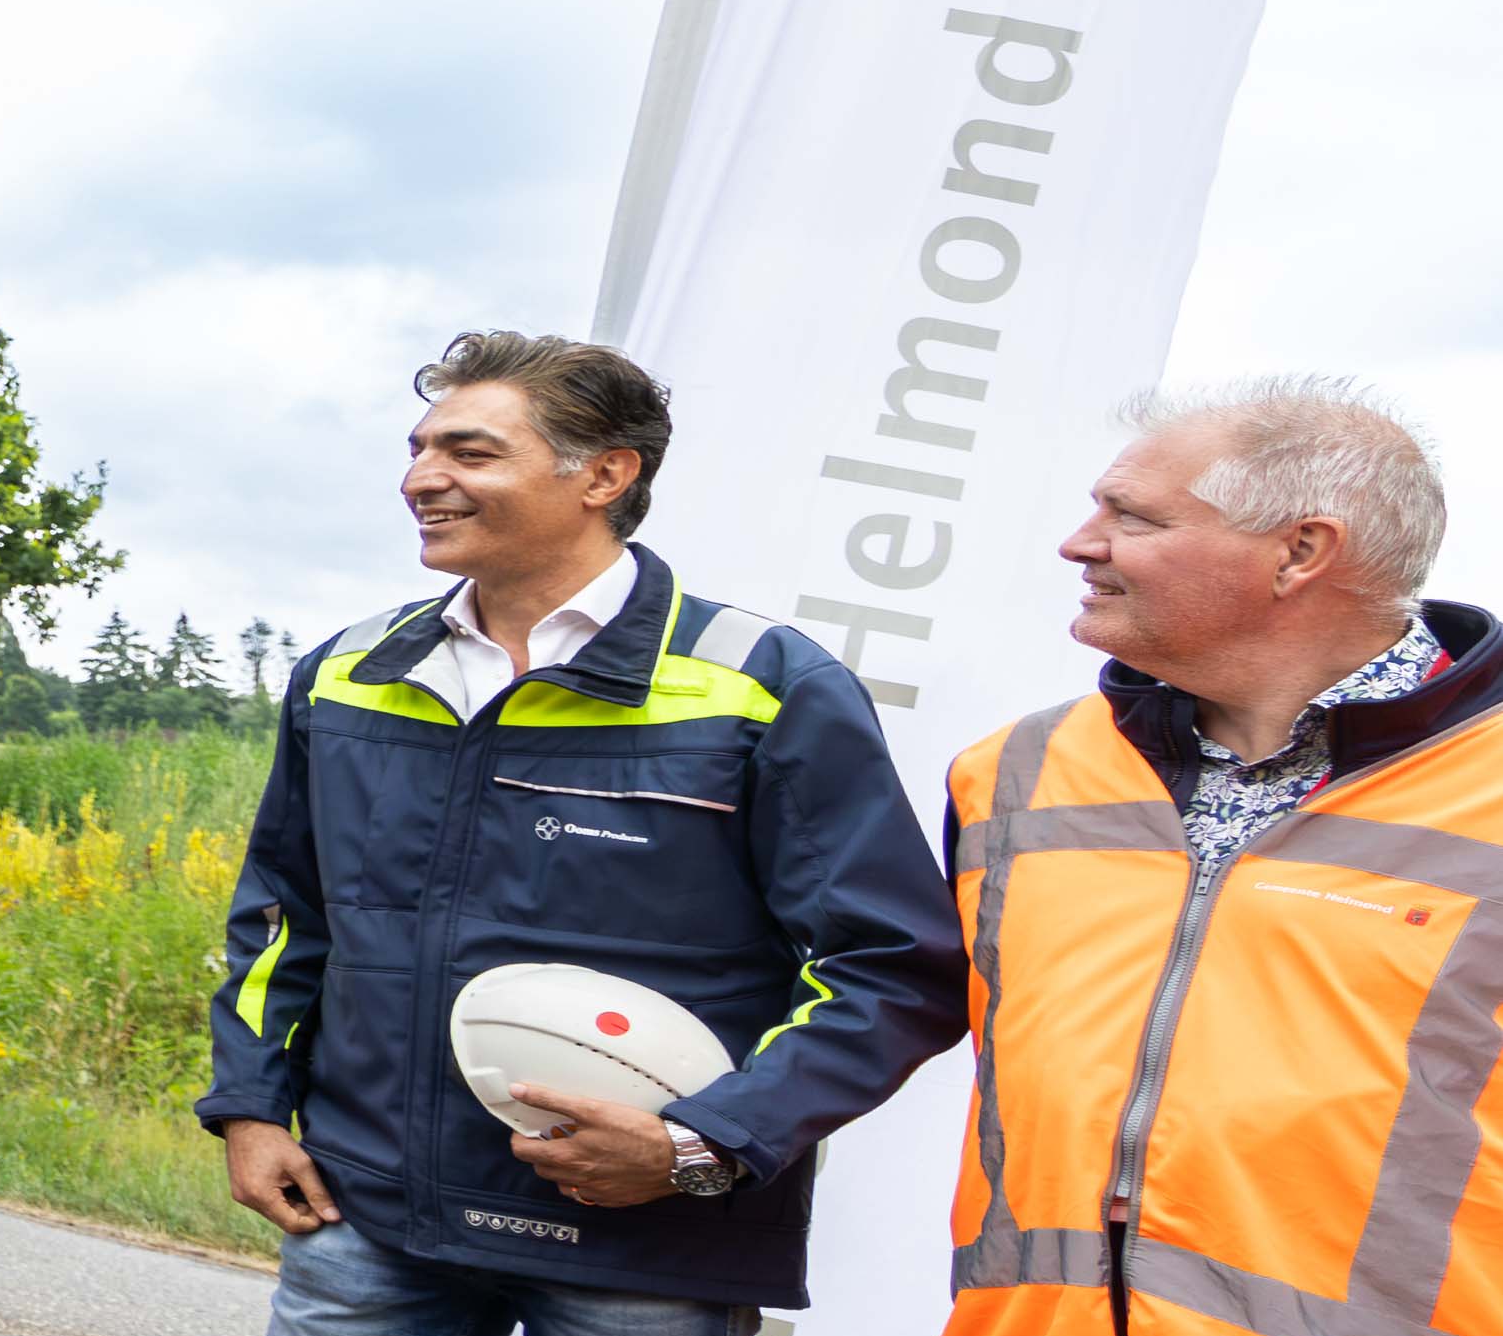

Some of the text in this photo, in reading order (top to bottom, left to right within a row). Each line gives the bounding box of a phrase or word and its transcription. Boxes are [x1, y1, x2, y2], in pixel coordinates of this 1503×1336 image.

[792, 7, 1084, 710] Helmond
[1253, 880, 1395, 915] Gemeente Helmond
